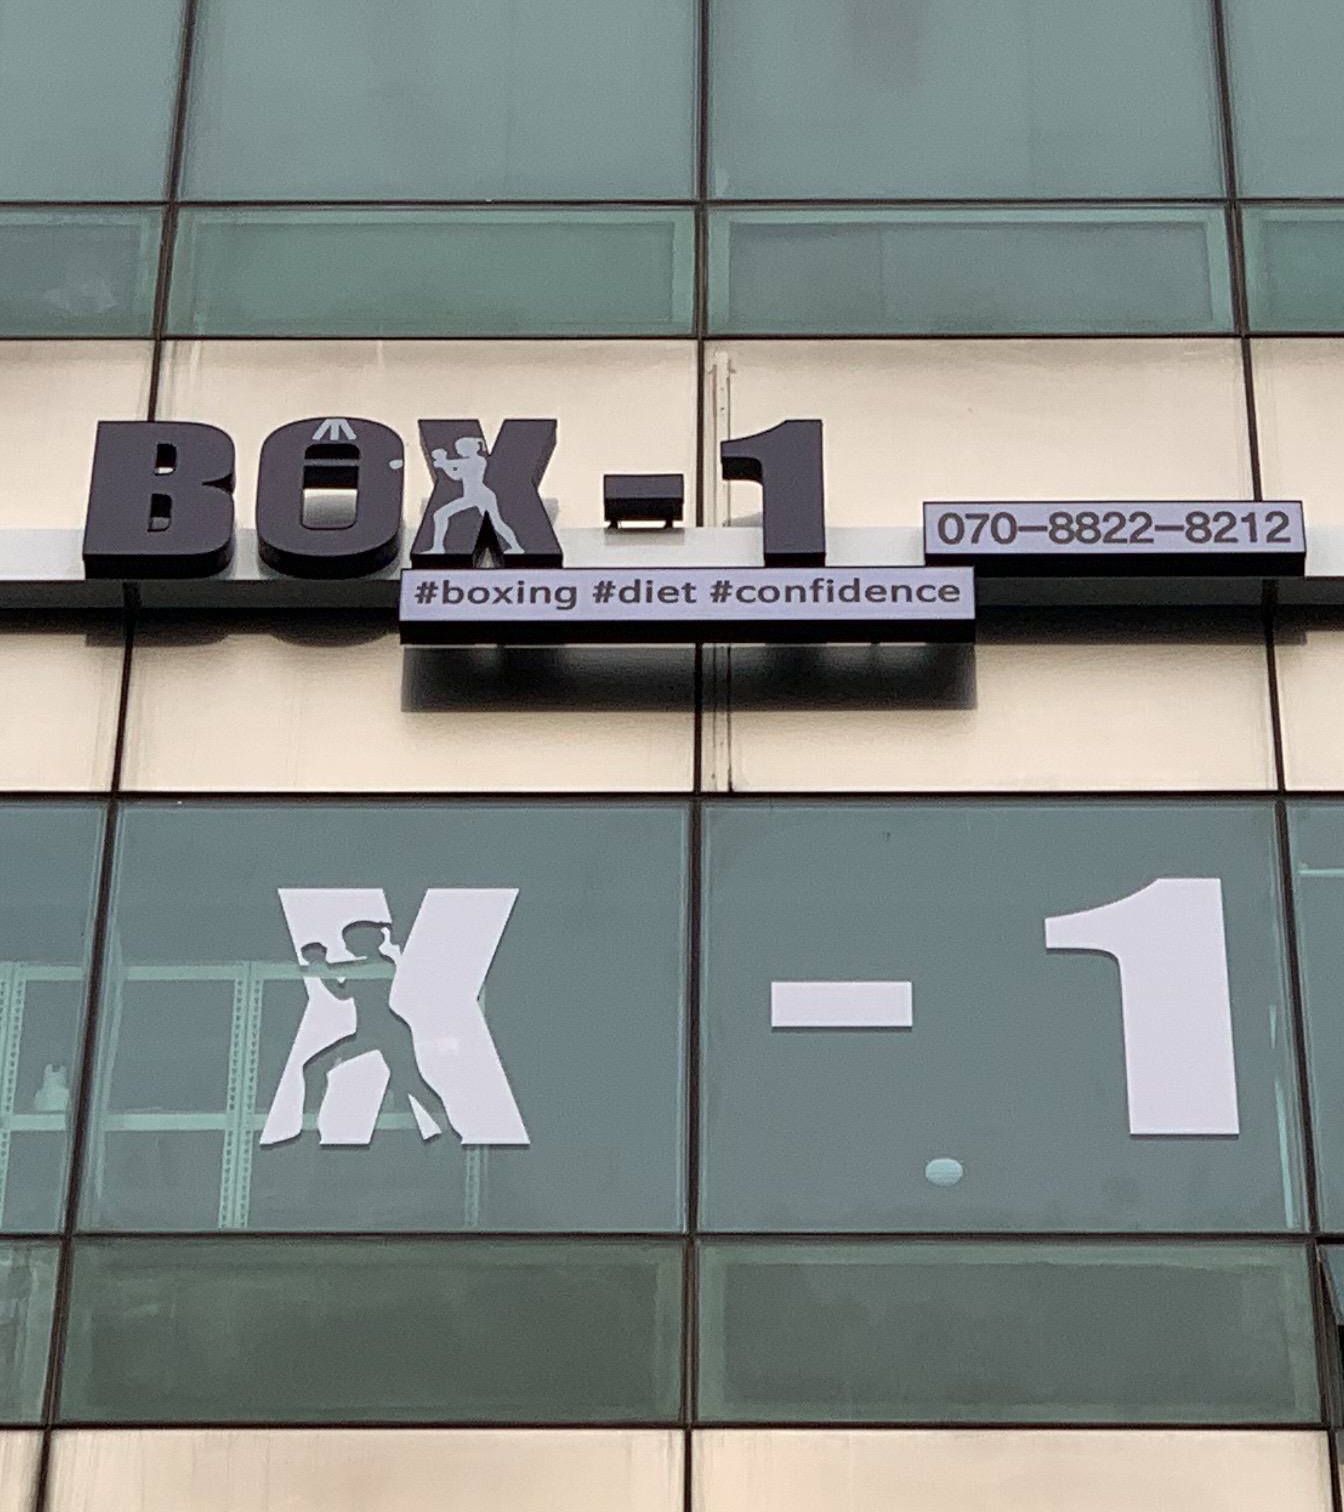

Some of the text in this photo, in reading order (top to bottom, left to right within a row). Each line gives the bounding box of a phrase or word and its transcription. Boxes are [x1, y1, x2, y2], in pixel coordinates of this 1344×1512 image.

[937, 510, 1292, 545] 070-8822-8212
[414, 576, 961, 610] #boxing #diet #confidence
